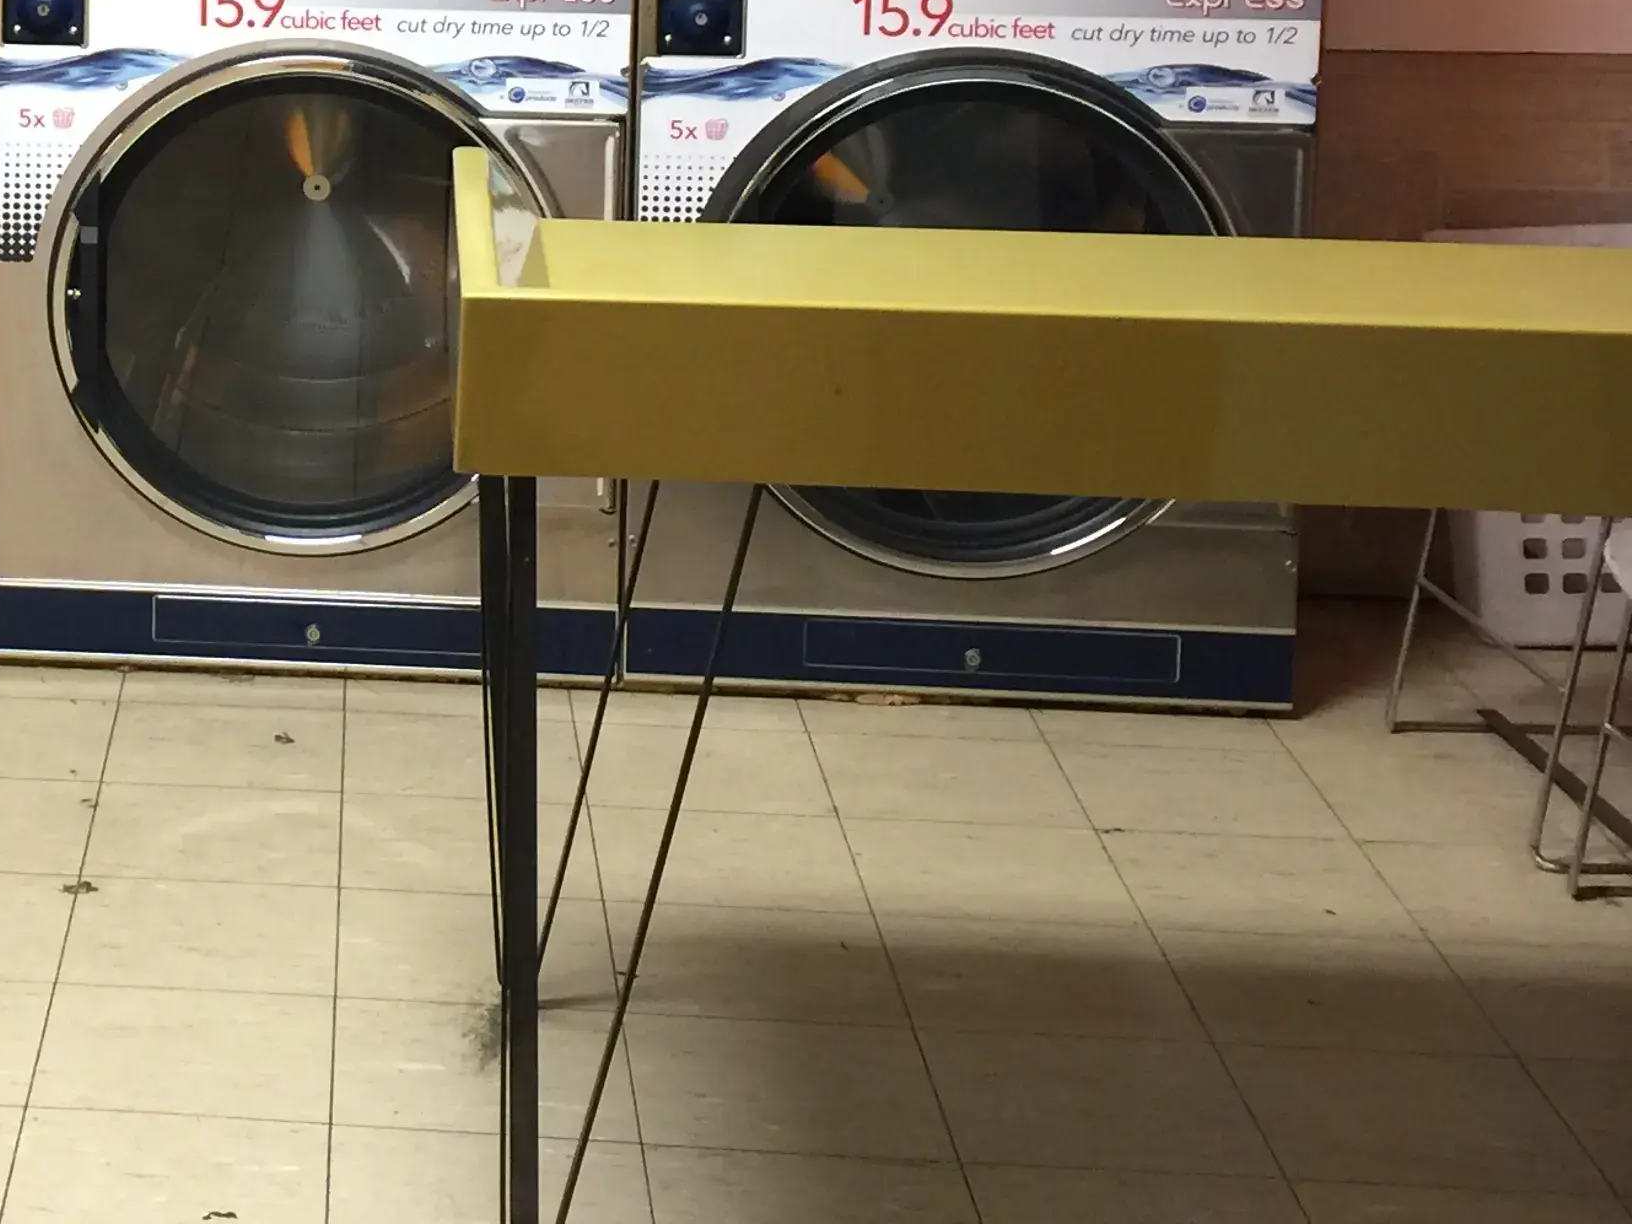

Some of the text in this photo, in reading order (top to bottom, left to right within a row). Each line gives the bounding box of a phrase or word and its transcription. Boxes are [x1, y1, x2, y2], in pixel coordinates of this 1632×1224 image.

[280, 12, 334, 29] cubic
[342, 12, 381, 31] feet
[398, 16, 610, 40] cut dry time up to 1/2
[947, 16, 1006, 37] cubic
[1012, 20, 1055, 38] feet
[1072, 24, 1299, 48] cut dry time up to 1/2
[20, 108, 45, 128] 5x
[670, 119, 700, 140] 5x
